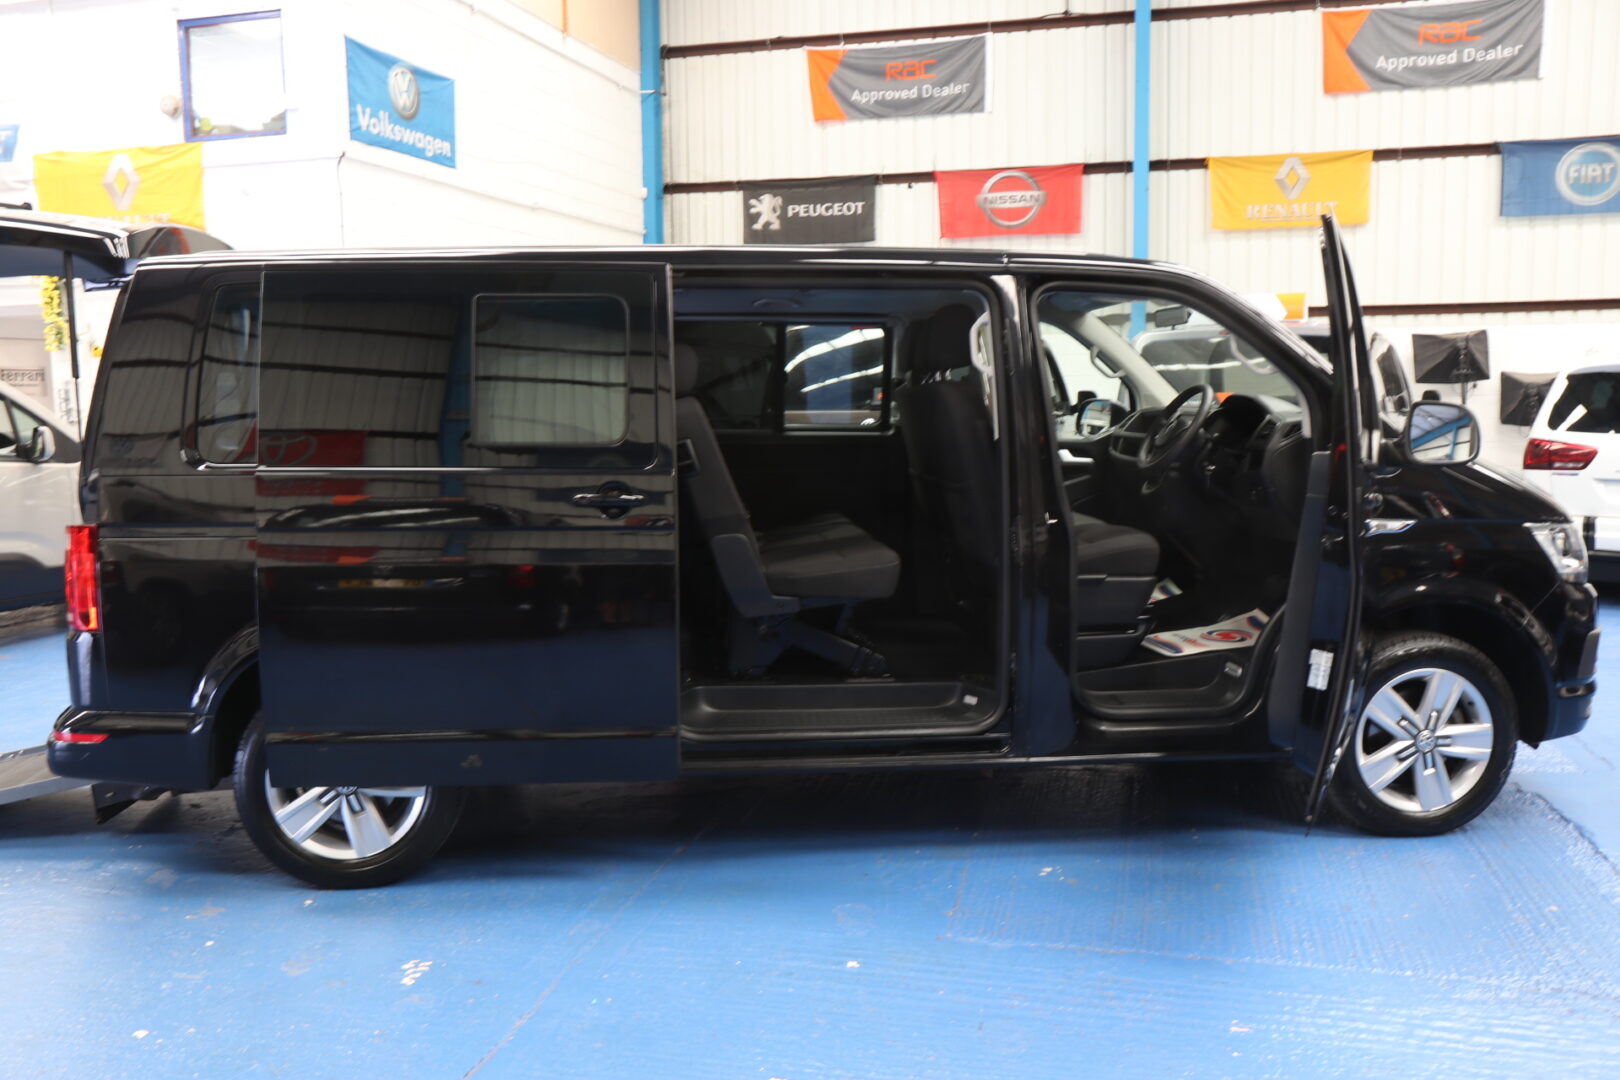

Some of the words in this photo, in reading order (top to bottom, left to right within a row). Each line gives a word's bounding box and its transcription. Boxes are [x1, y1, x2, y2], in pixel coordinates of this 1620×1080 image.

[1375, 49, 1457, 72] Approved
[1462, 44, 1524, 63] Dealer
[850, 86, 918, 104] Approved
[922, 83, 970, 98] Dealer
[356, 104, 452, 157] Volkswagen
[1569, 162, 1616, 184] FIAT
[787, 201, 865, 218] PEUGEOT
[982, 194, 1040, 205] NISSAN
[1247, 201, 1338, 219] RENAULT
